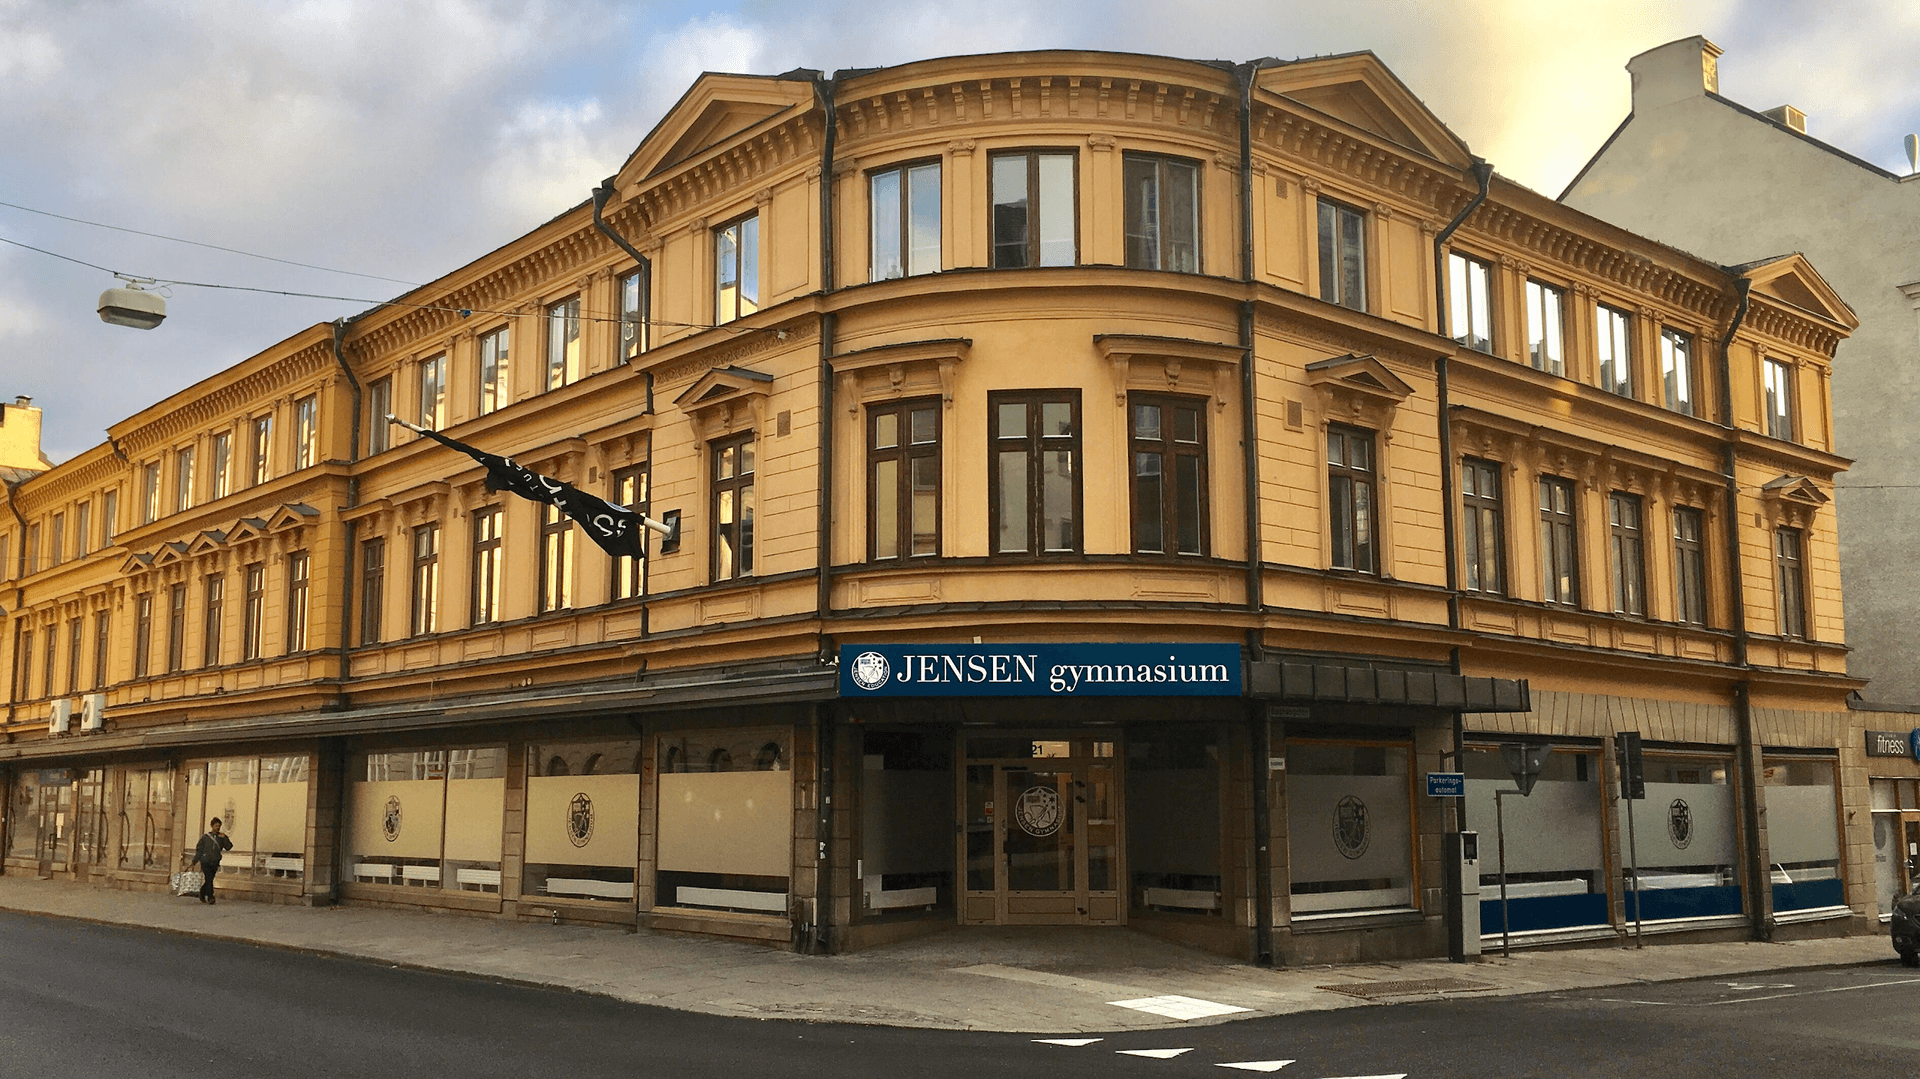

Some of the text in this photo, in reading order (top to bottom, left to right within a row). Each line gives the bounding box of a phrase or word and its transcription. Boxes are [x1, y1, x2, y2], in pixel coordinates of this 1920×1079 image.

[896, 654, 1230, 693] JENSEN gymnasium
[1877, 734, 1905, 754] fitness
[1430, 776, 1462, 786] Parkerings-
[1435, 786, 1457, 794] automat
